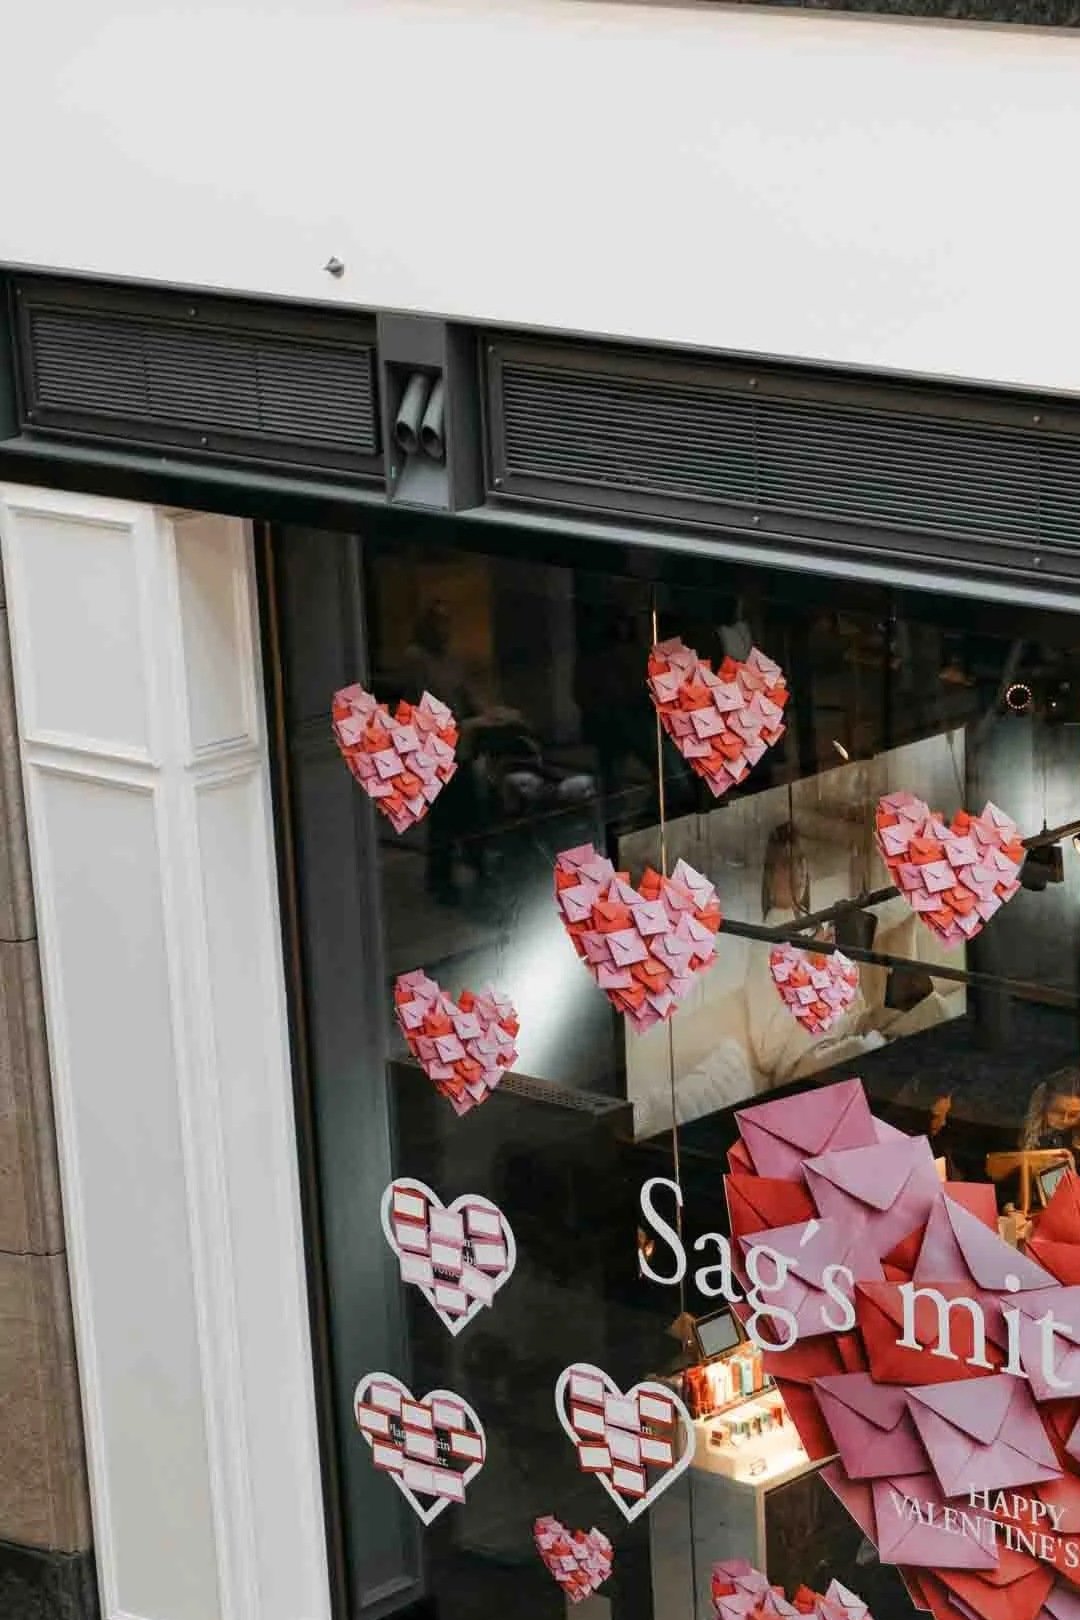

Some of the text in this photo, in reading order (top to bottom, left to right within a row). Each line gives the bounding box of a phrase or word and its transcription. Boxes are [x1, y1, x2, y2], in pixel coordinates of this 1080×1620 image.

[895, 1273, 1073, 1391] mit
[888, 1490, 1080, 1569] VALENTINE'S
[967, 1482, 1066, 1532] HAPPY
